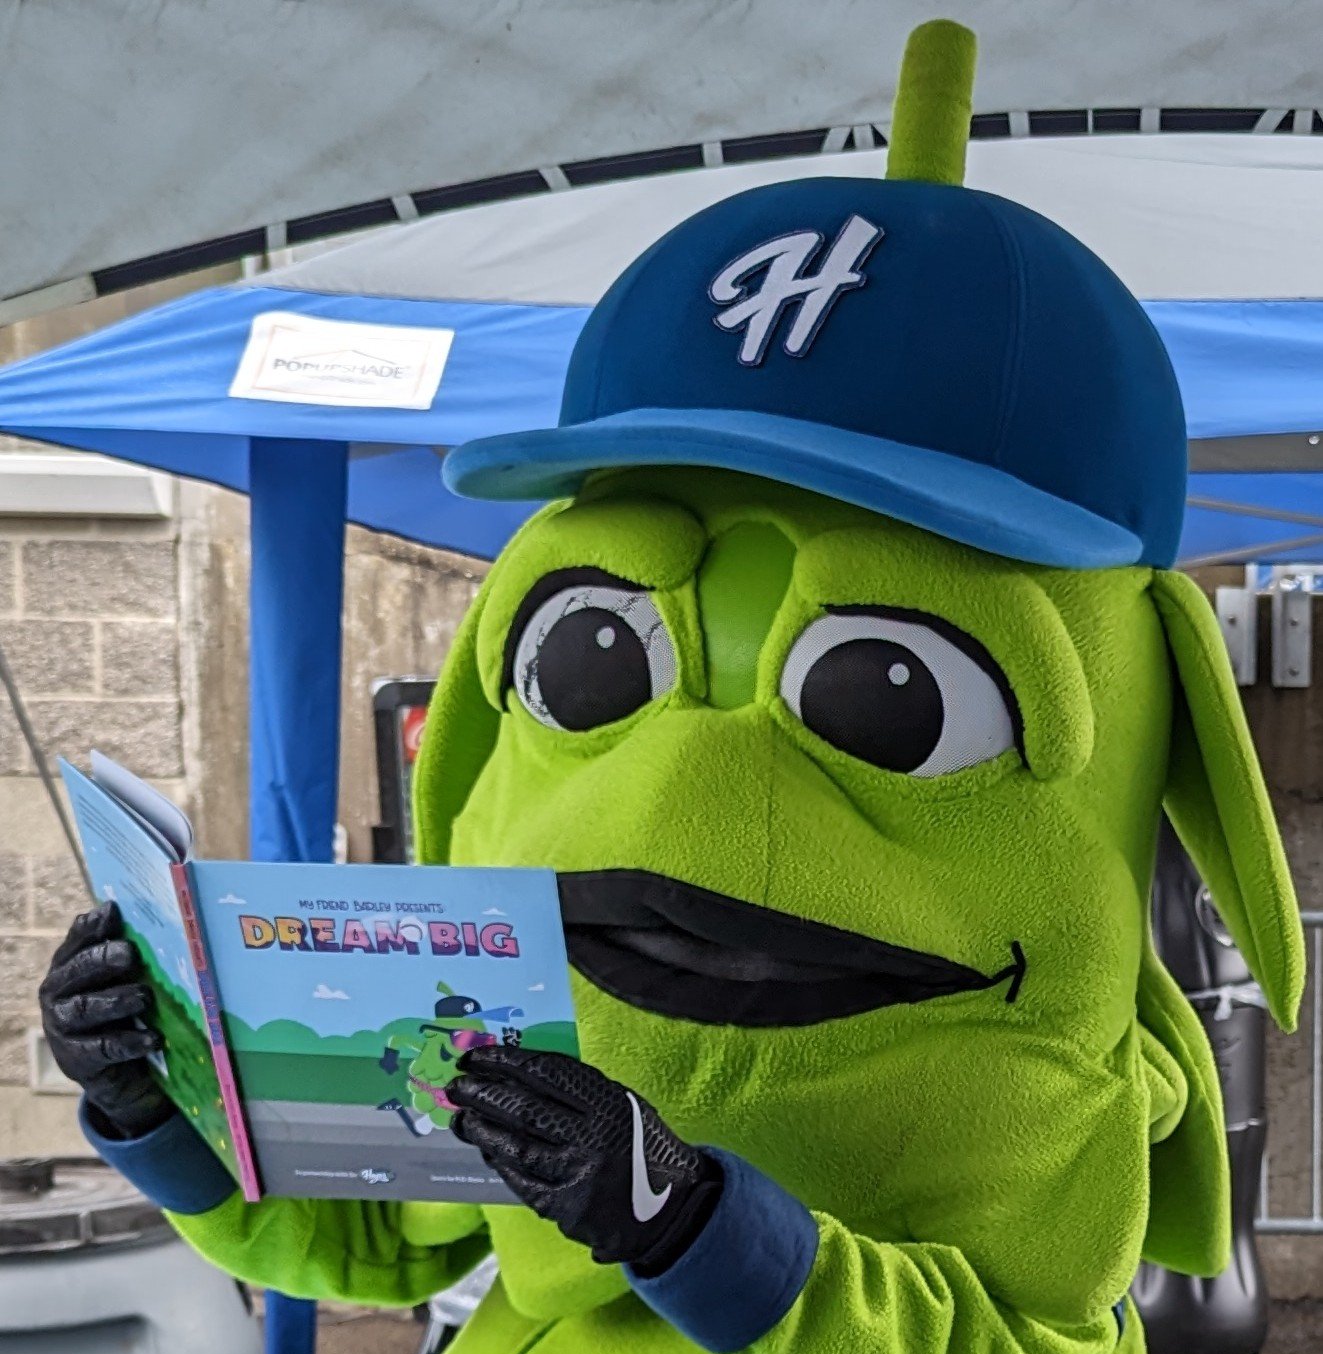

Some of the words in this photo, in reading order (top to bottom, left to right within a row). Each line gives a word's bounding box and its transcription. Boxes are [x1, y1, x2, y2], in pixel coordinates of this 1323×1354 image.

[708, 213, 884, 365] H
[273, 357, 403, 380] POPUPSHADE
[298, 899, 314, 910] MY
[316, 900, 349, 911] FRIEND
[353, 901, 391, 913] BARLEY
[395, 902, 444, 914] PRESENTS
[239, 914, 421, 956] DREAM
[428, 921, 520, 959] BIG
